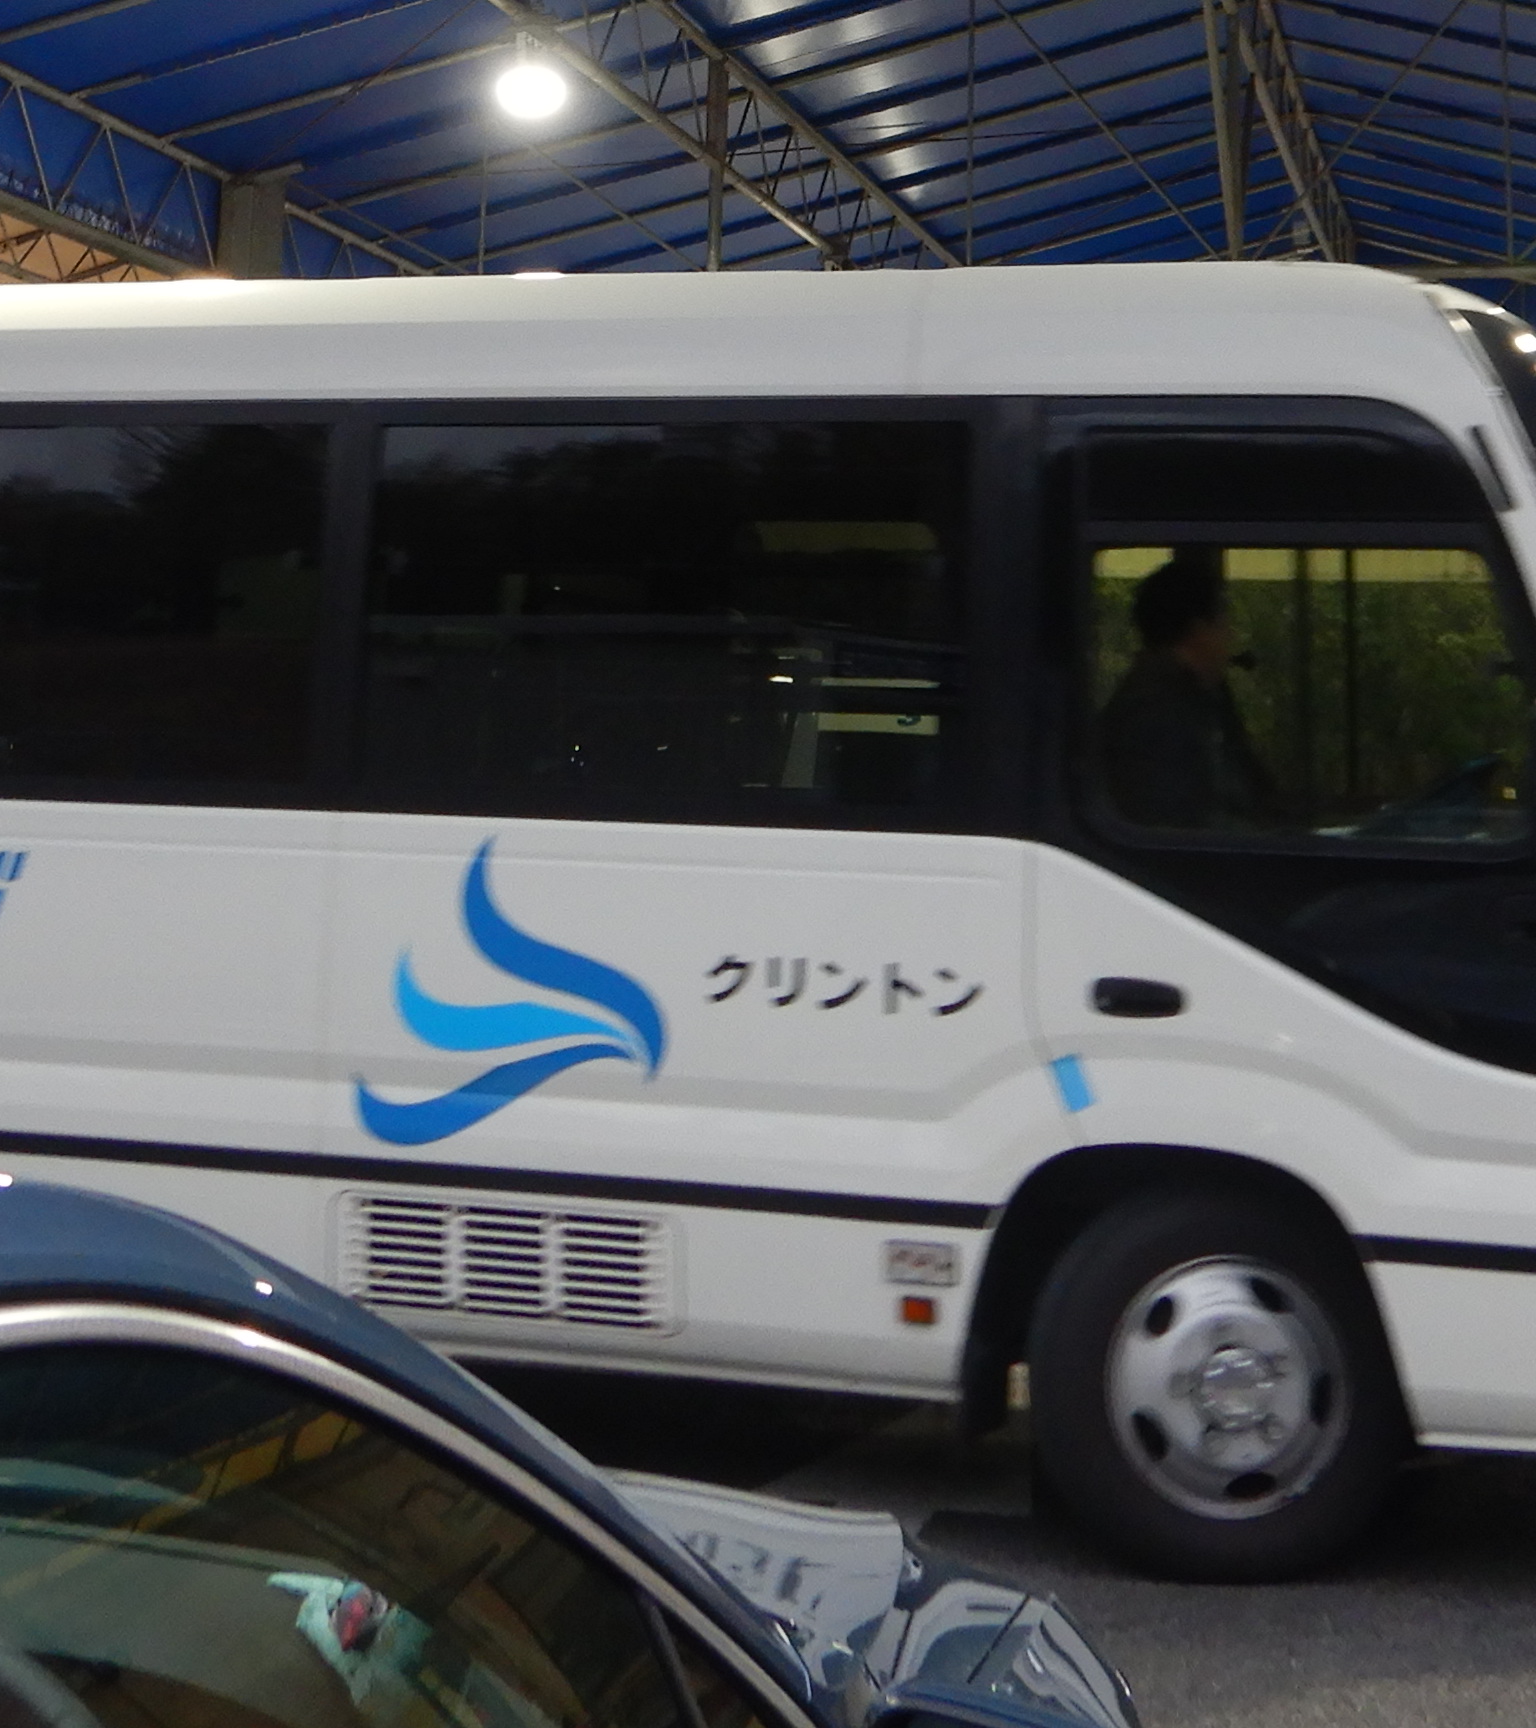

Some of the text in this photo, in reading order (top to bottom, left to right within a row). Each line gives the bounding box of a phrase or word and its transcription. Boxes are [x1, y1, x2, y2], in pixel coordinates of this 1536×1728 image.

[704, 954, 986, 1018] クリントン
